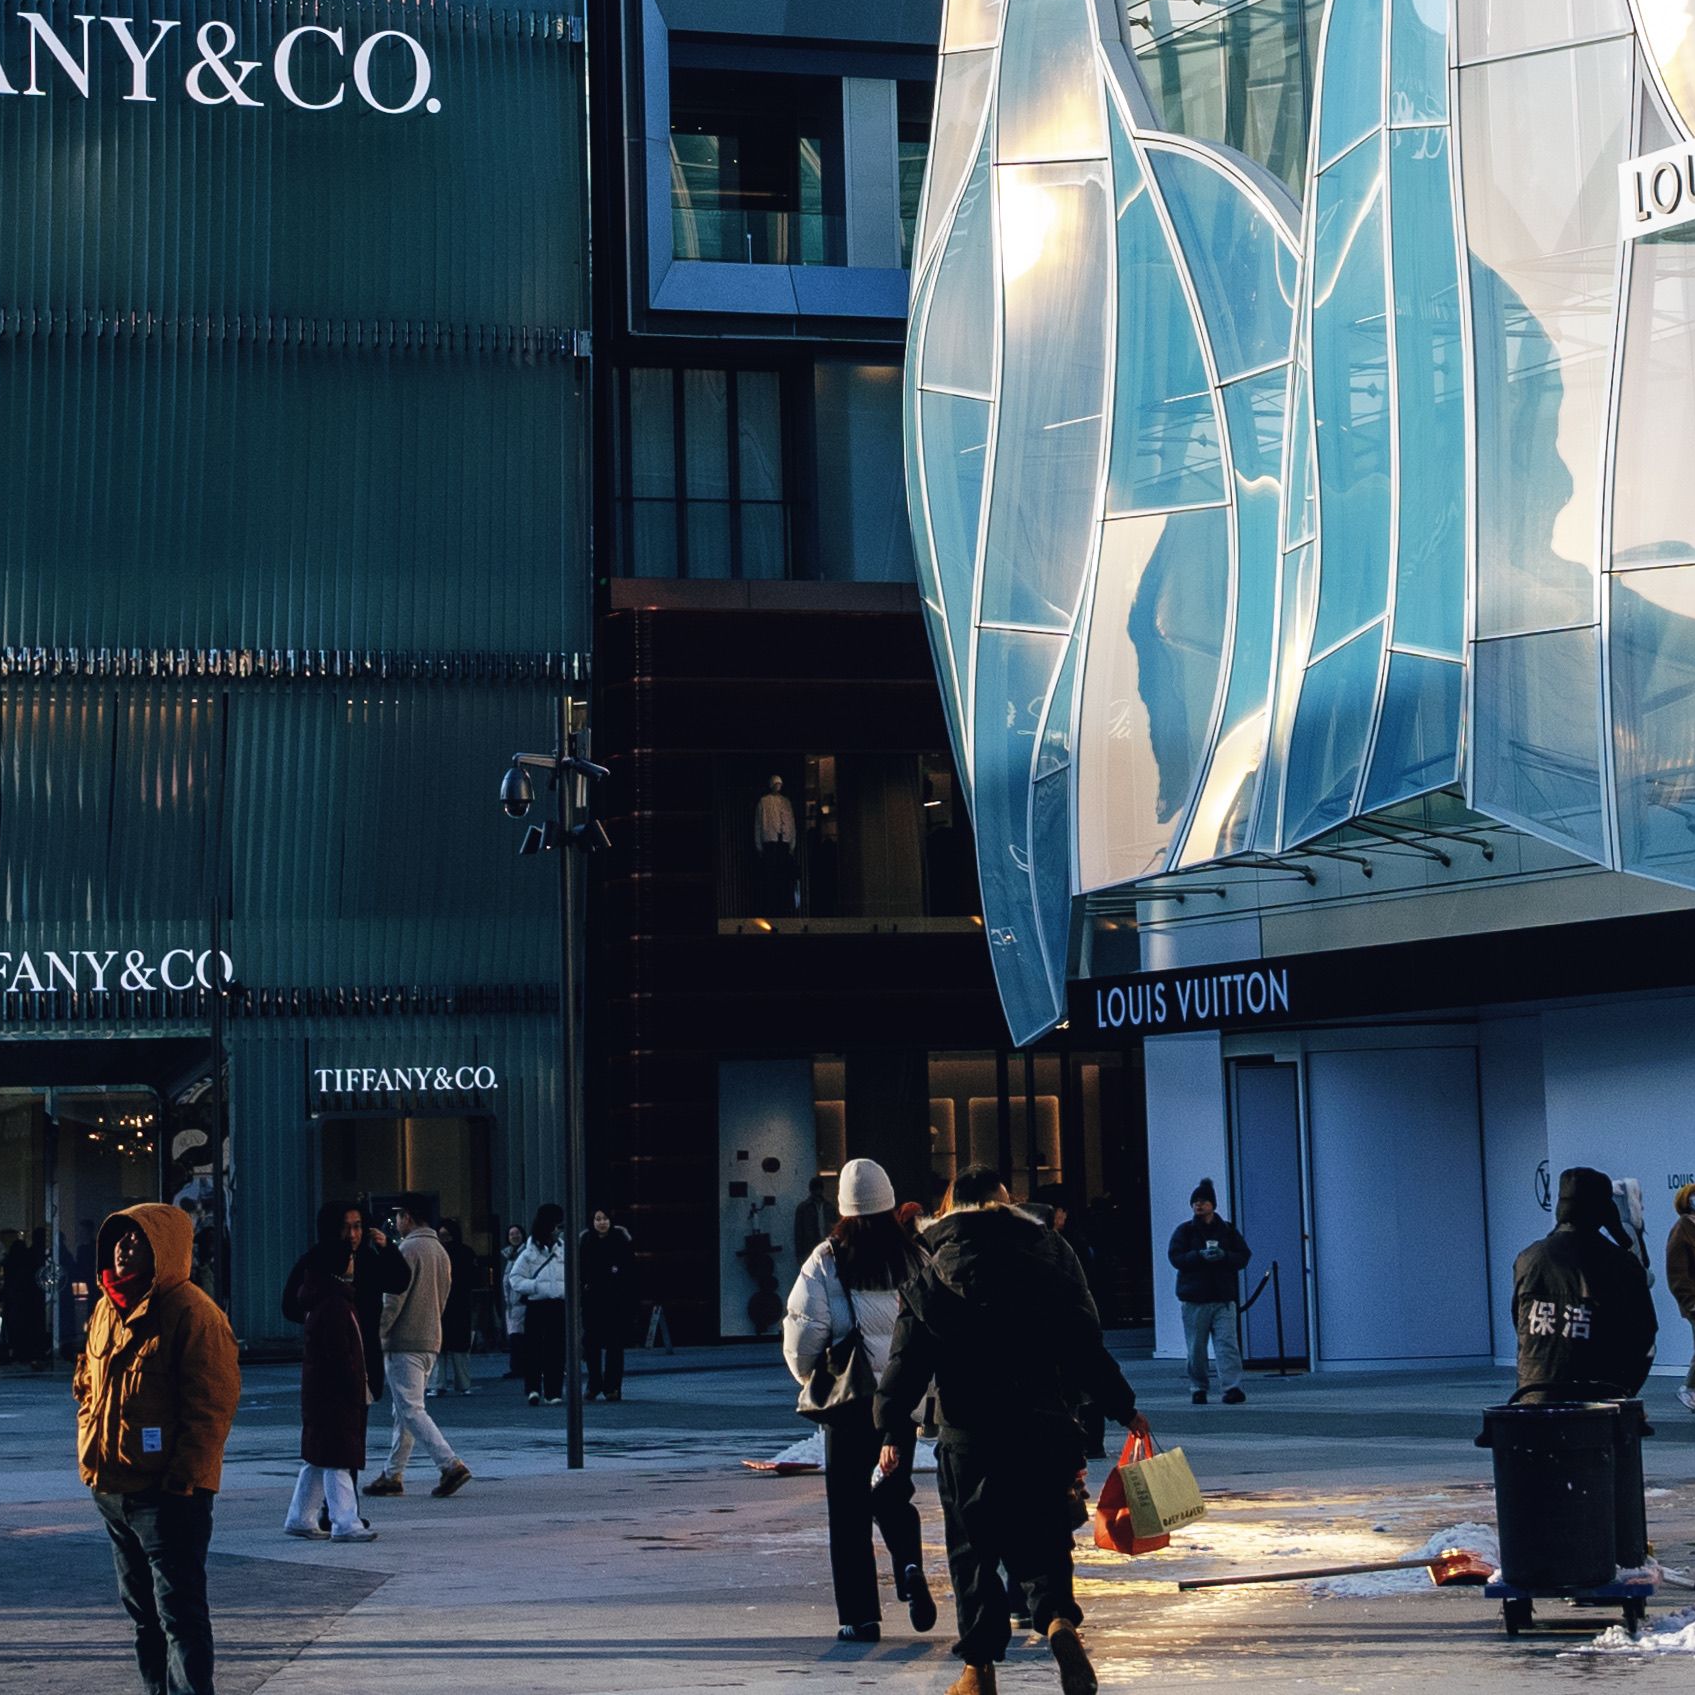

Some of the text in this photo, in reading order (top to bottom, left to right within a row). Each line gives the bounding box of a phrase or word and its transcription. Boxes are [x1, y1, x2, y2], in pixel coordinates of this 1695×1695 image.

[1096, 969, 1289, 1028] LOUIS VUITTON
[314, 1065, 499, 1092] TIFFANY&CO.
[1527, 1299, 1592, 1340] 保洁
